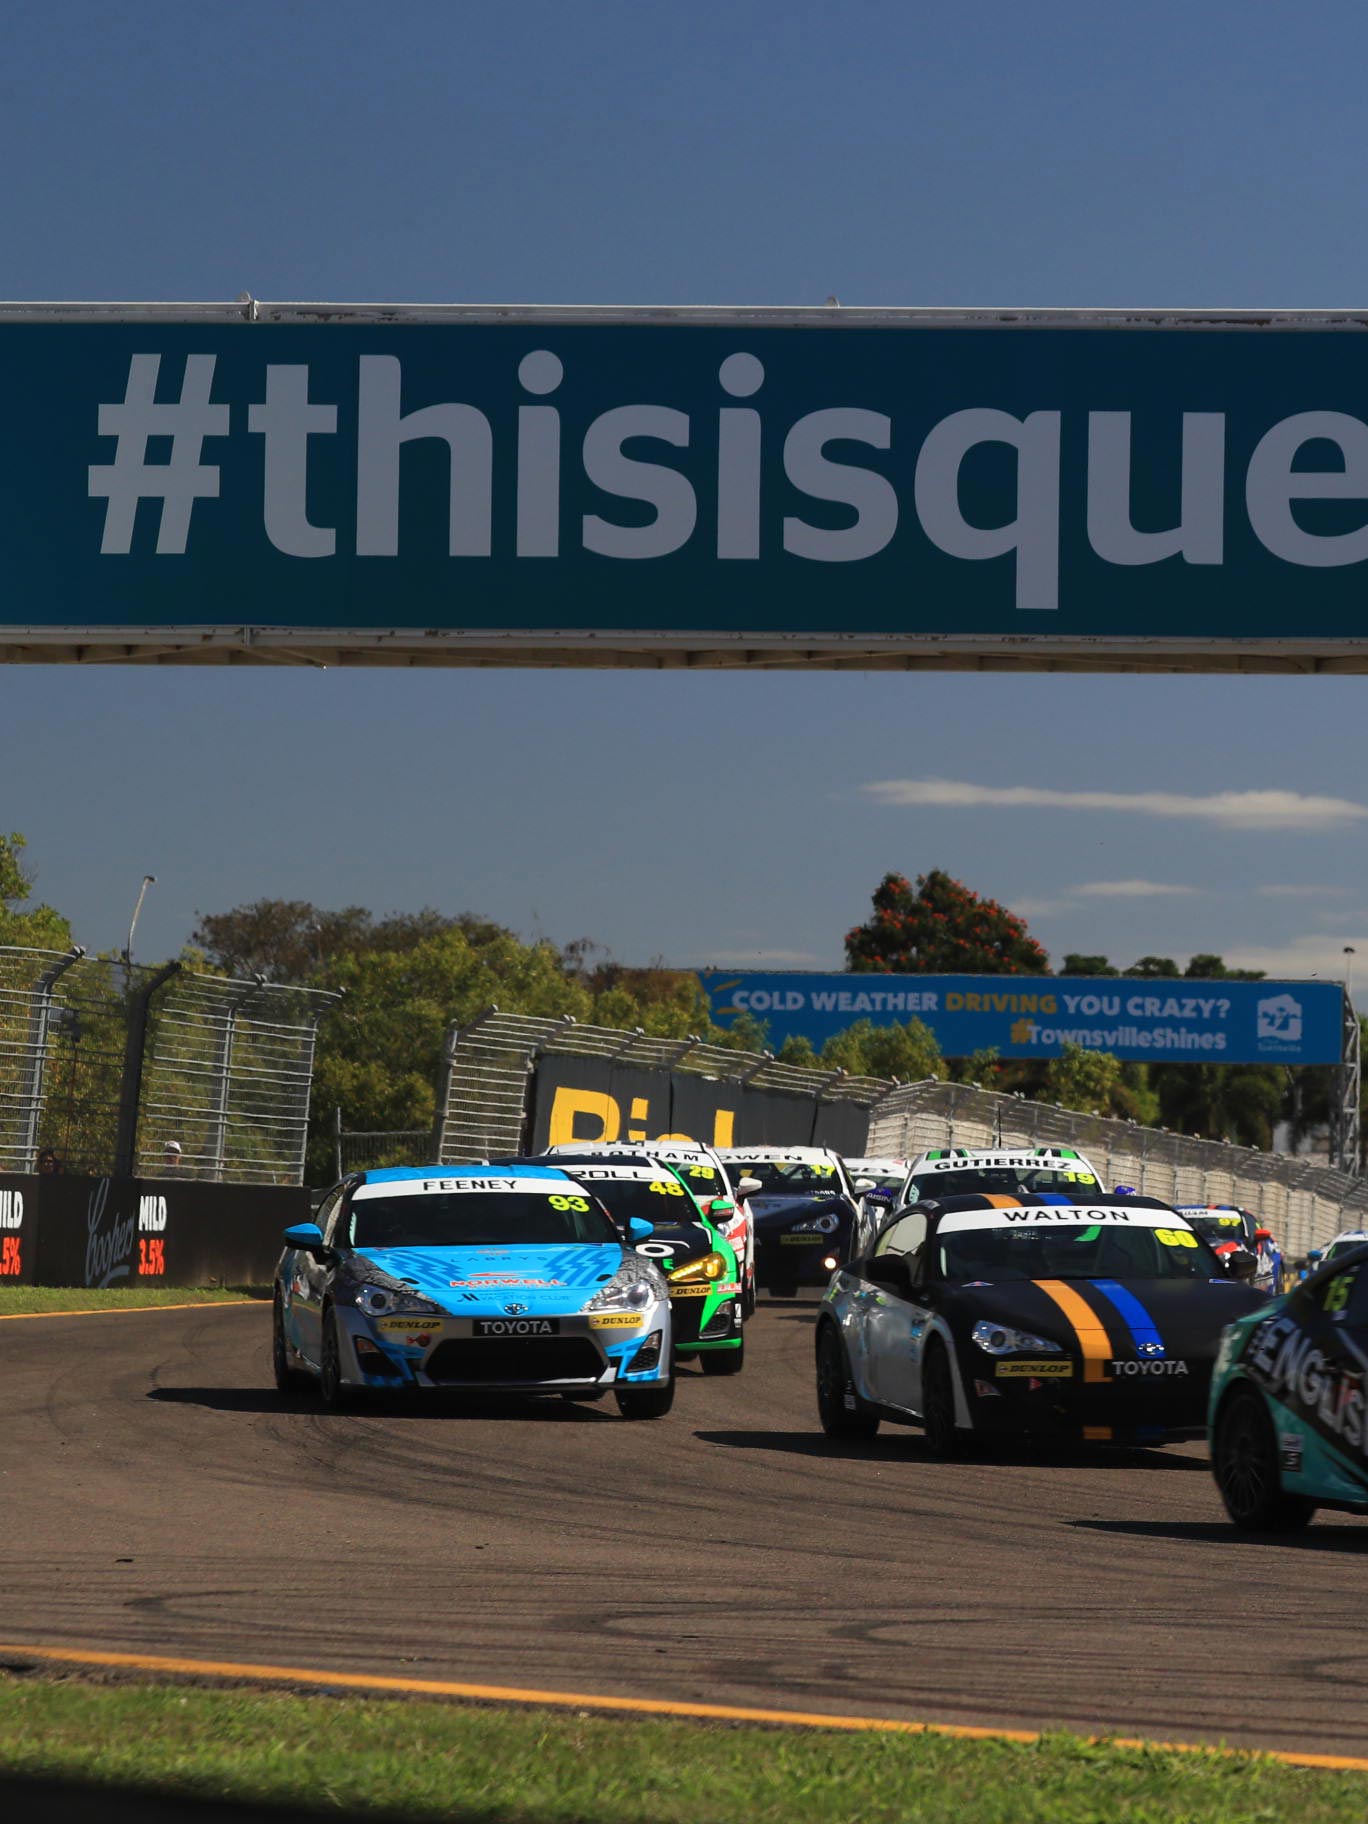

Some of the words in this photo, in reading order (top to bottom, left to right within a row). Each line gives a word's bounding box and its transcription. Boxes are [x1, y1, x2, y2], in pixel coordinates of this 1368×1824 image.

[732, 991, 804, 1012] COLD
[811, 991, 938, 1012] WEATHER
[945, 993, 1057, 1014] DRIVING
[1063, 995, 1119, 1016] YOU
[1127, 996, 1230, 1019] CRAZY?
[1011, 1018, 1227, 1050] #TownsvilleShines
[934, 1158, 1072, 1171] GUTIERREZ
[688, 1165, 715, 1180] 29
[1063, 1172, 1096, 1185] 19
[423, 1179, 518, 1192] FEENEY
[649, 1181, 684, 1197] 48
[548, 1195, 590, 1213] 93
[138, 1196, 167, 1232] MILD
[1003, 1209, 1130, 1222] WALTON
[1154, 1229, 1199, 1248] 60
[138, 1239, 165, 1275] 3.5%
[449, 1278, 564, 1288] NORWELL
[675, 1287, 711, 1296] DUNLOP
[389, 1321, 440, 1329] DUNLOP
[480, 1320, 552, 1335] TOYOTA
[601, 1315, 641, 1325] DUNLOP
[1010, 1364, 1070, 1374] DUNLOP
[1112, 1360, 1189, 1375] TOYOTA
